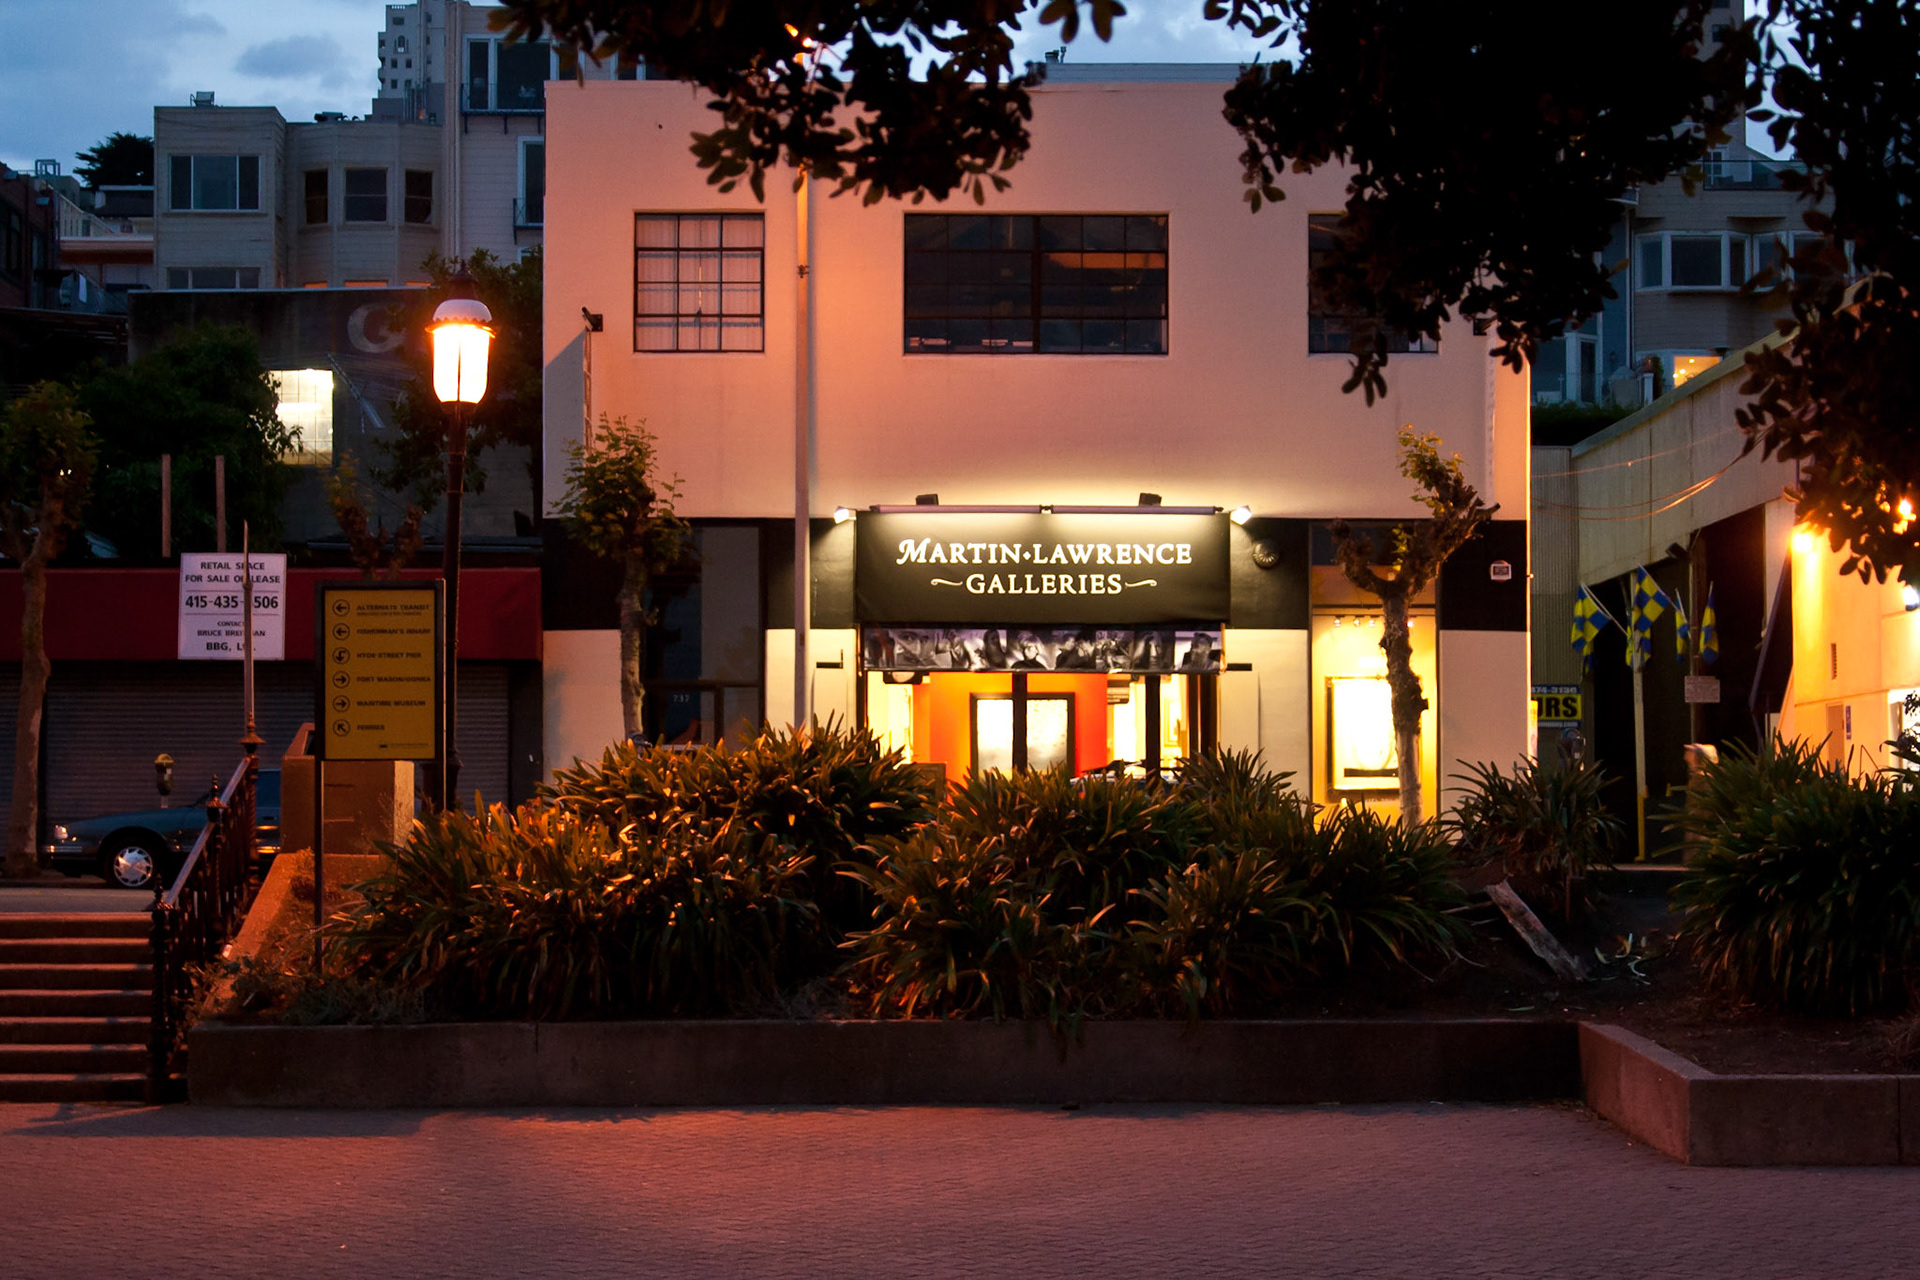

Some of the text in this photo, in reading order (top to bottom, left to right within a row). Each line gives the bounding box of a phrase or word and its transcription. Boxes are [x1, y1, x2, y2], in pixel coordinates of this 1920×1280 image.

[200, 562, 231, 570] RETAIL
[185, 575, 203, 583] FOR
[207, 575, 230, 583] SALE
[251, 575, 281, 584] LEASE
[965, 573, 1123, 595] GALLERIES
[185, 595, 279, 609] 415-435-506
[206, 642, 232, 652] BBG,
